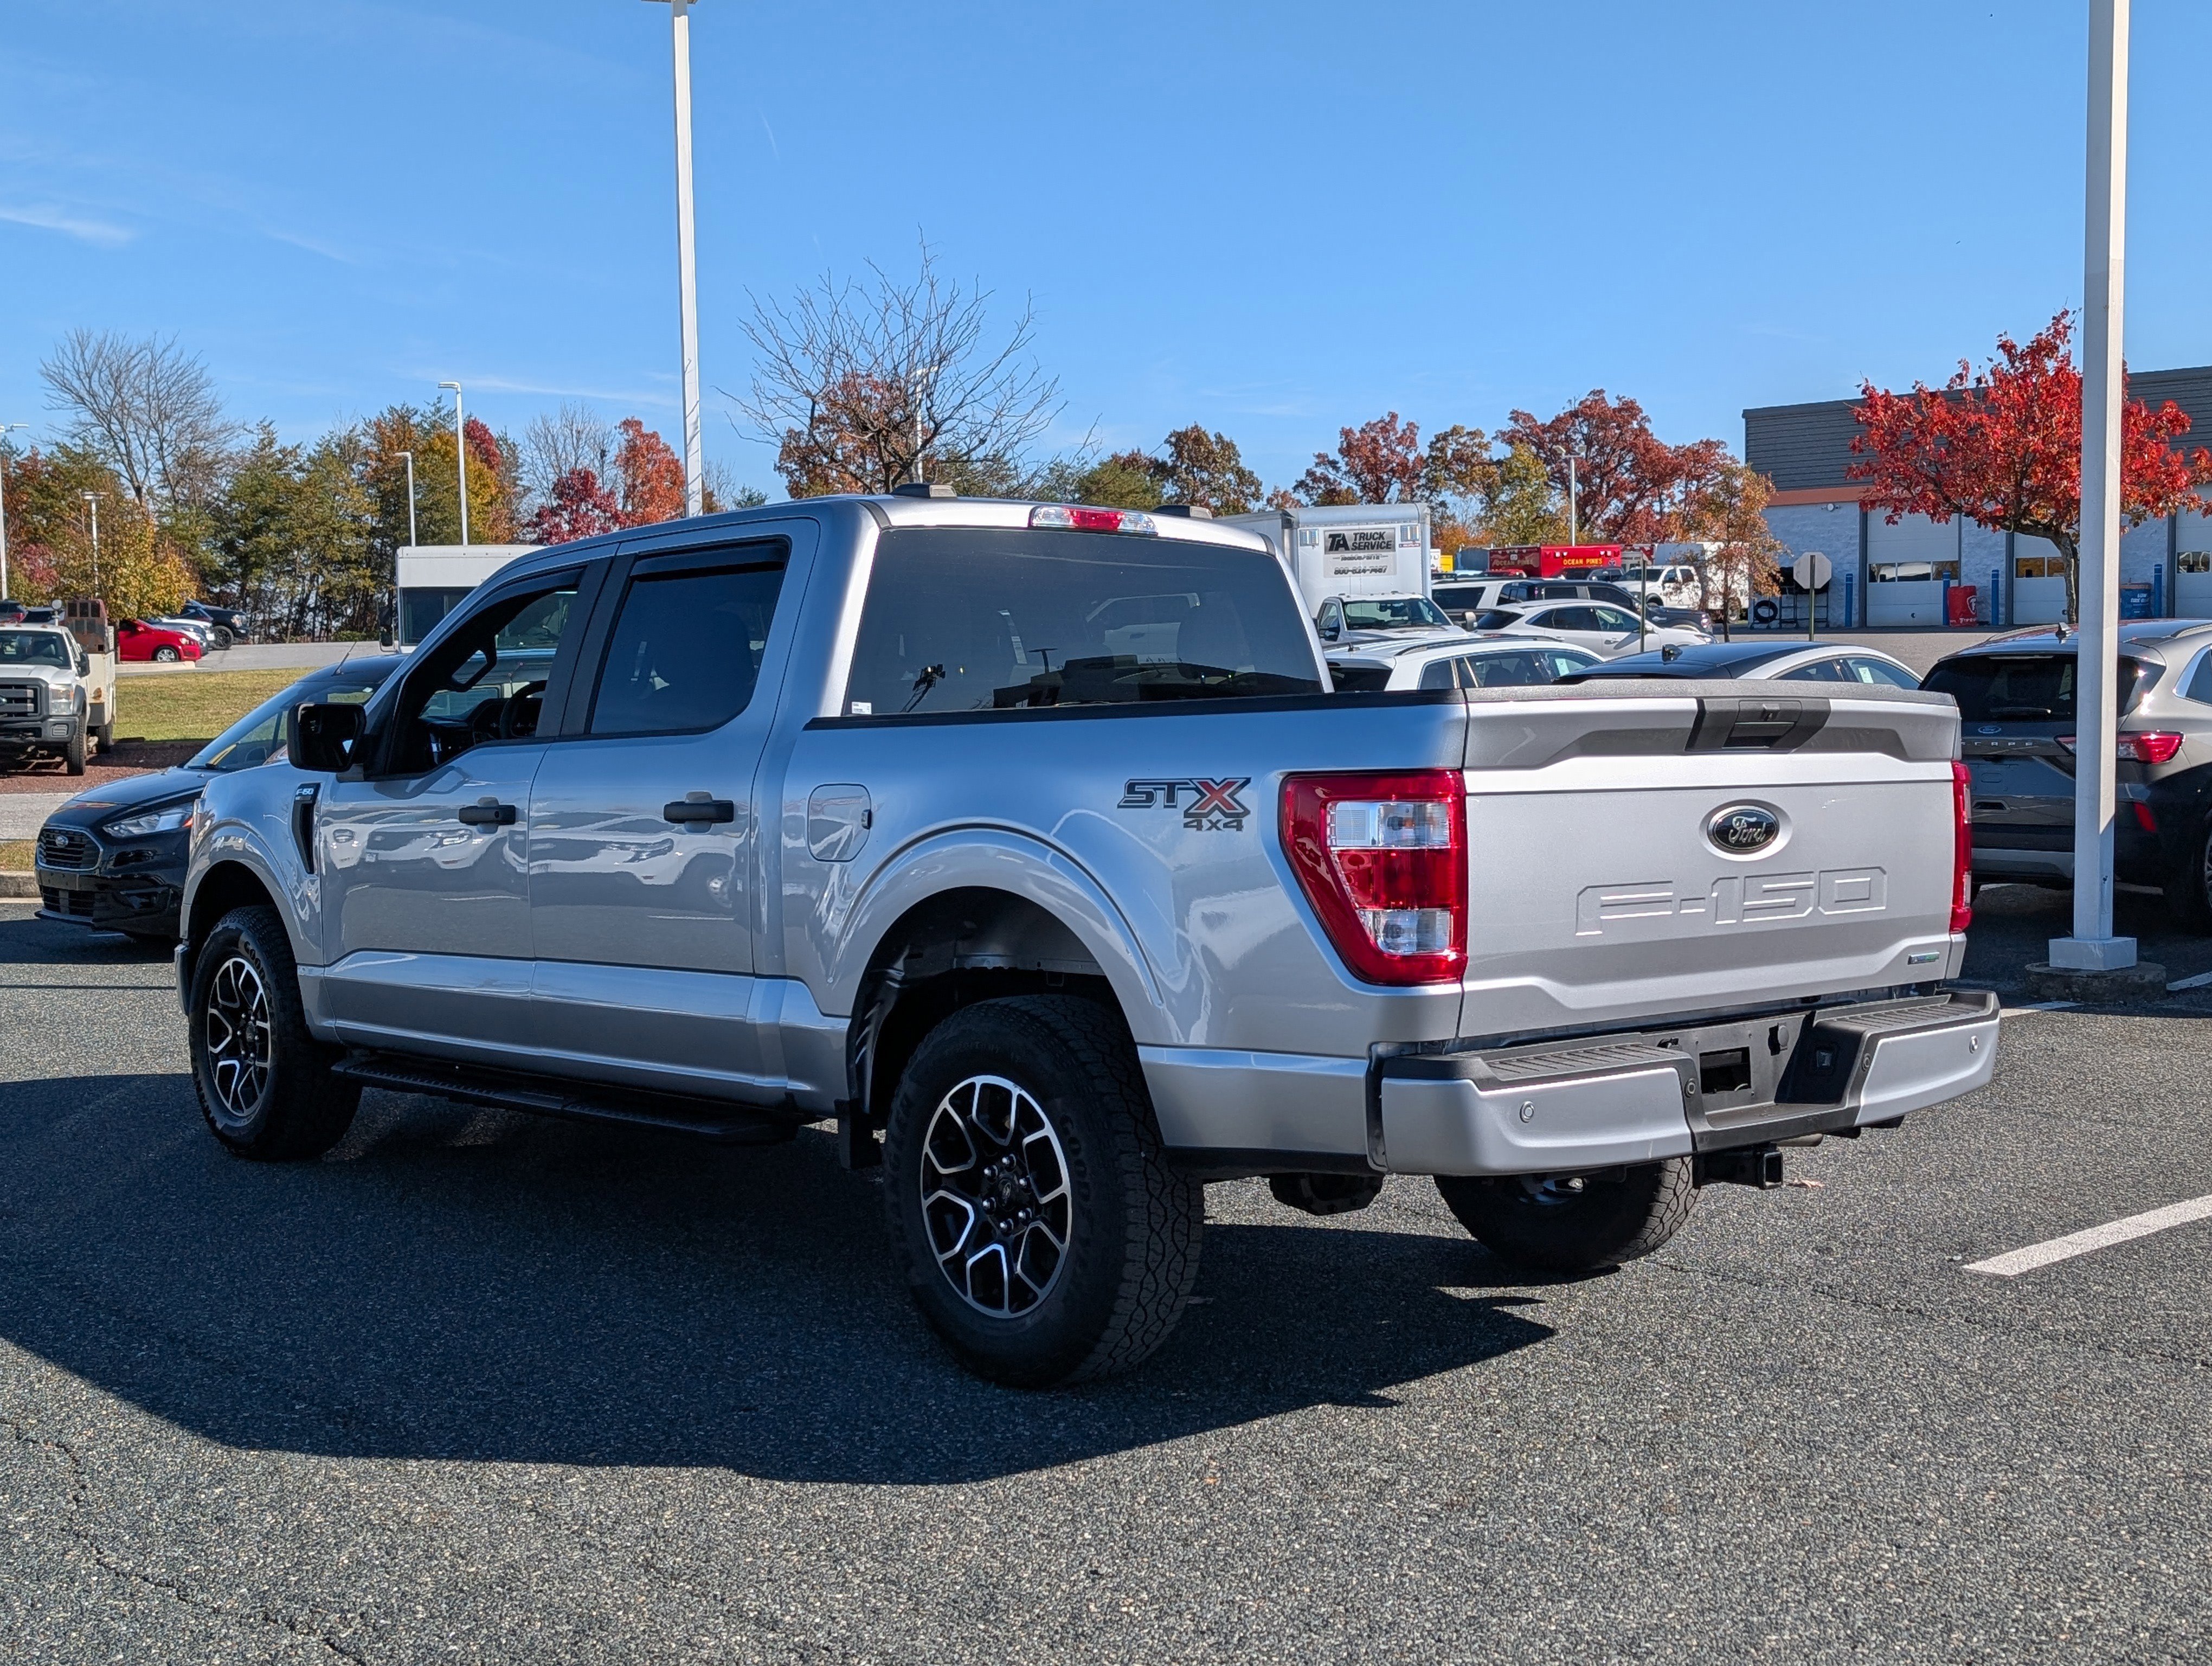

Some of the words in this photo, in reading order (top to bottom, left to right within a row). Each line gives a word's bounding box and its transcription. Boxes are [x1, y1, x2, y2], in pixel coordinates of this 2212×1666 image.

[1328, 533, 1350, 551] TA
[1351, 541, 1392, 550] SERVICE
[1353, 531, 1386, 541] TRUCK
[1117, 777, 1252, 818] STX
[1728, 816, 1766, 844] Ford
[1576, 866, 1887, 936] F-150
